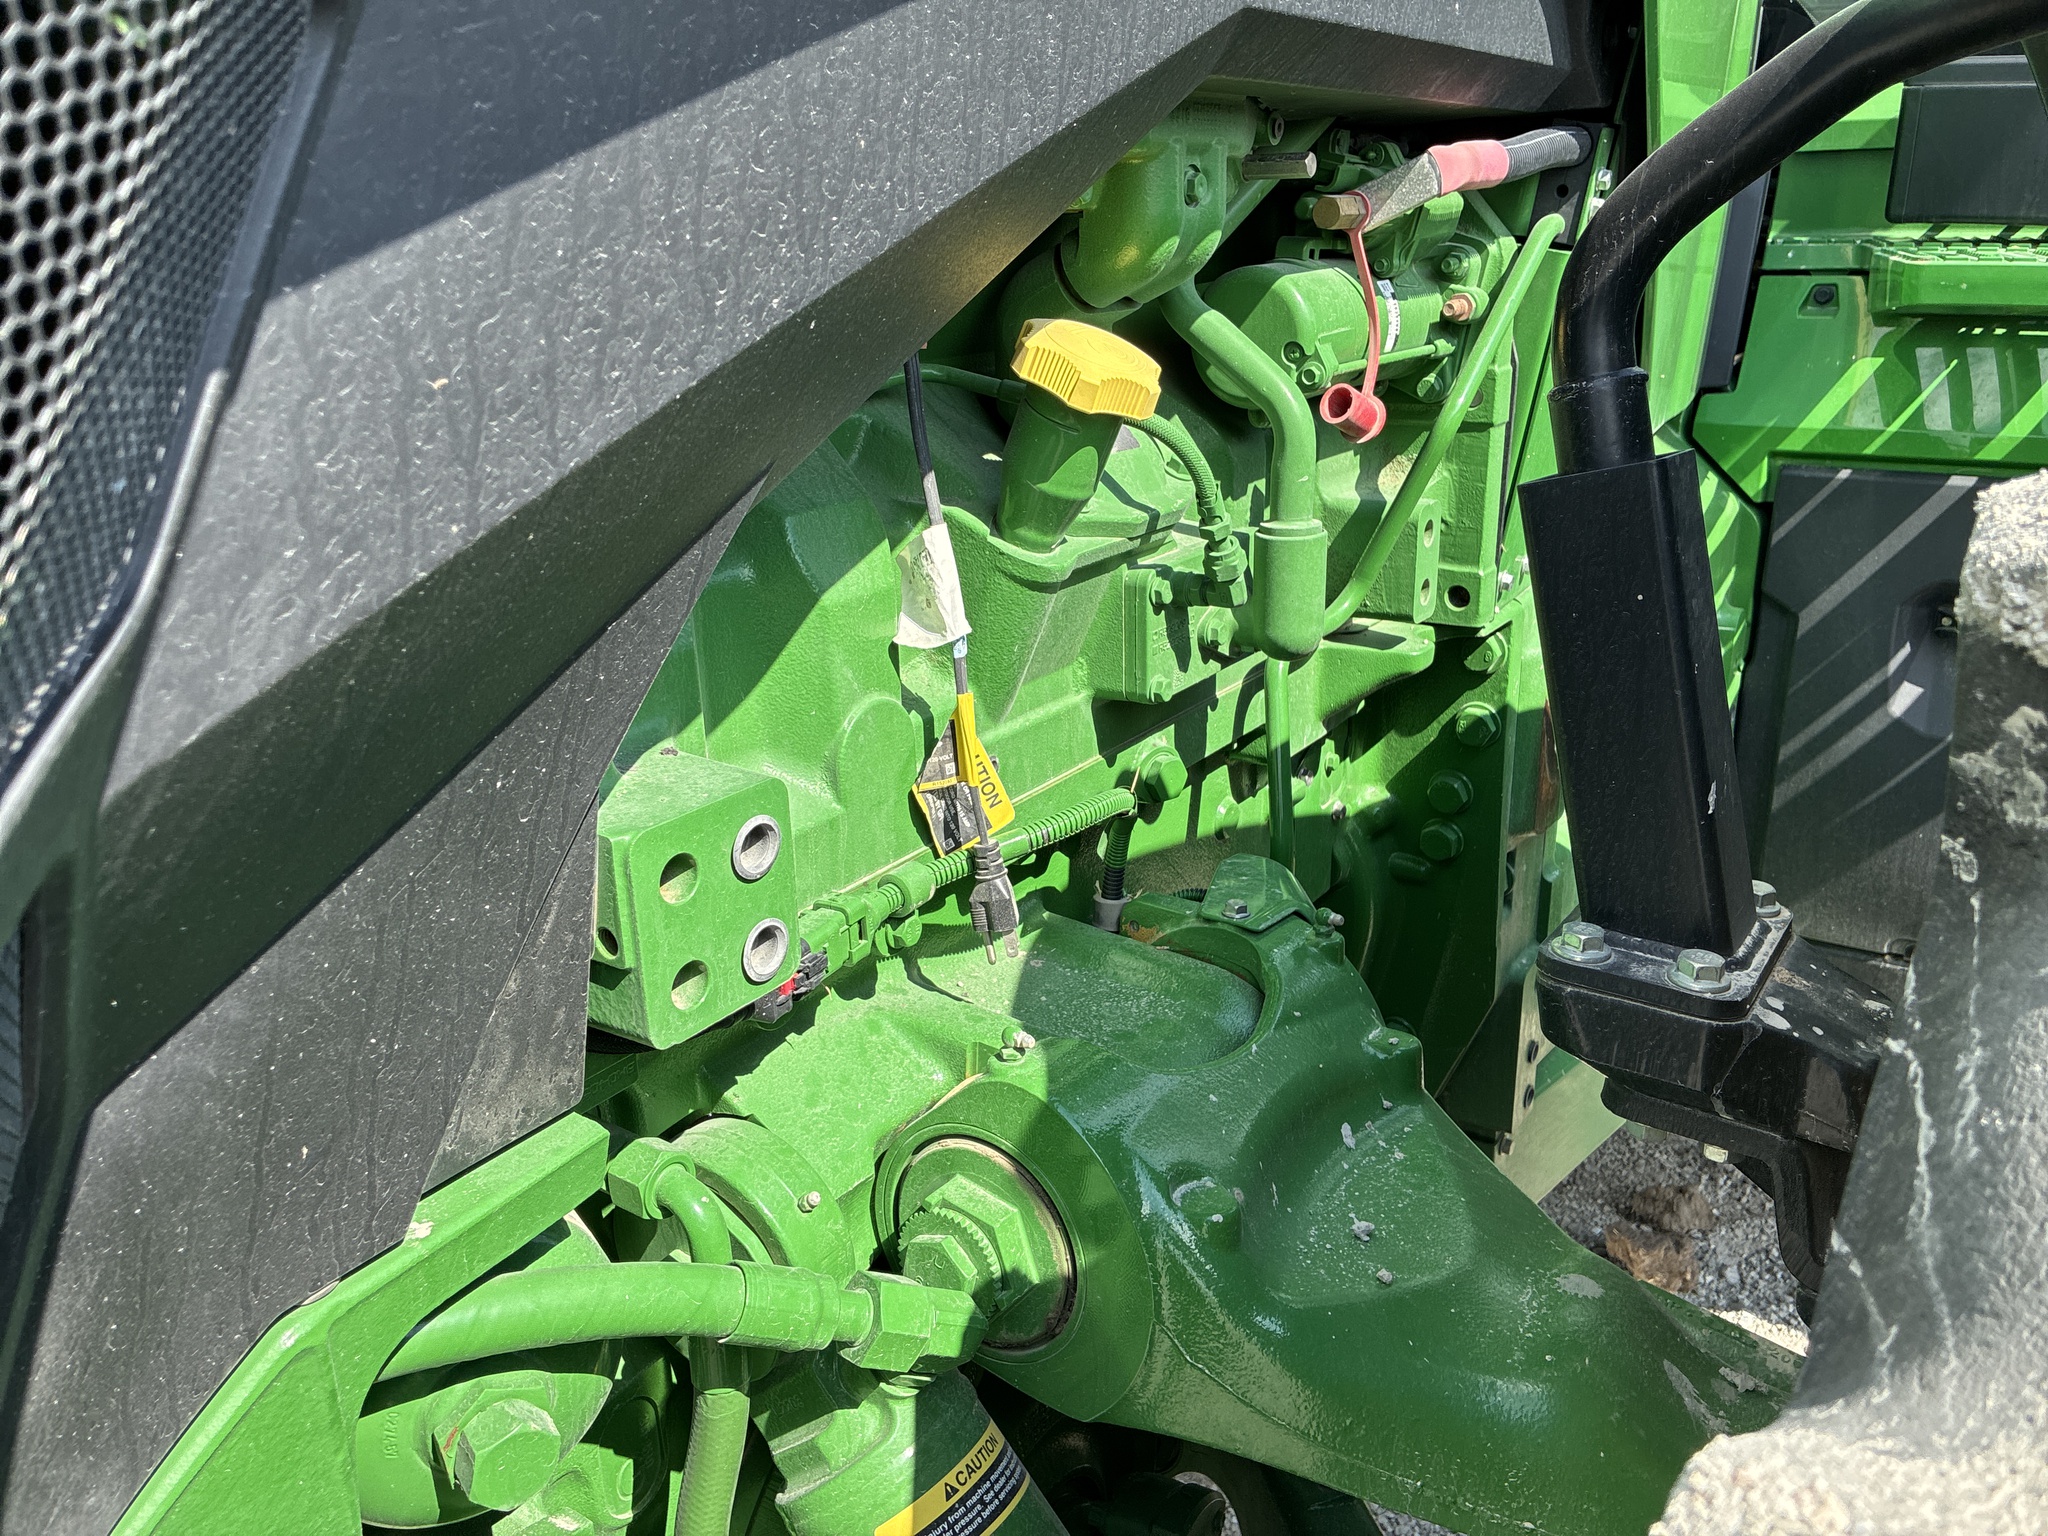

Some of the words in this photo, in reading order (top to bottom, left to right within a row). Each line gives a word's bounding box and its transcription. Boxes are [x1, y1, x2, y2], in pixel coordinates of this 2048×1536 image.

[939, 753, 953, 762] VOLT
[975, 753, 1003, 808] TION
[953, 828, 963, 842] VOLT
[955, 1432, 999, 1486] CAUTION
[948, 1506, 967, 1524] from
[965, 1480, 992, 1508] machine
[954, 1504, 984, 1534] pressure.
[983, 1490, 995, 1503] See
[994, 1475, 1007, 1492] dealer
[981, 1498, 1000, 1519] before
[998, 1477, 1017, 1501] servicing
